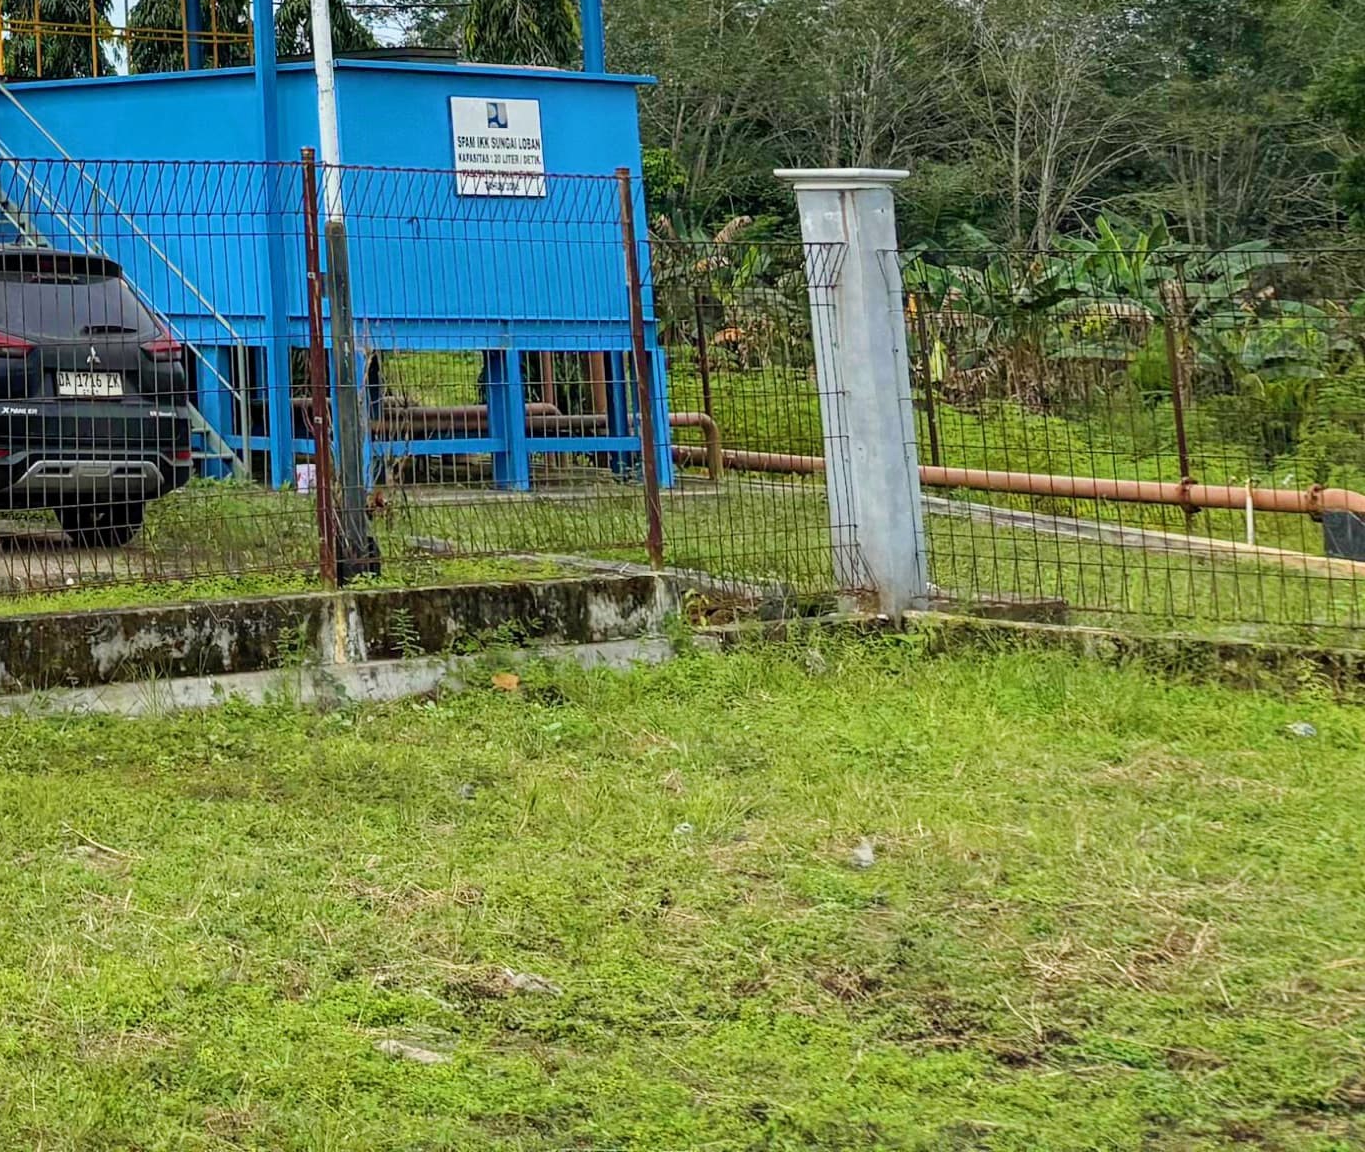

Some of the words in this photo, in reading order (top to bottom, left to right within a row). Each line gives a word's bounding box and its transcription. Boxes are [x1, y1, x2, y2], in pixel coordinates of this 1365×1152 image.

[458, 136, 475, 148] SPAM
[477, 136, 489, 148] IKK
[491, 137, 517, 149] SUNGAI
[518, 137, 540, 150] LOBAN
